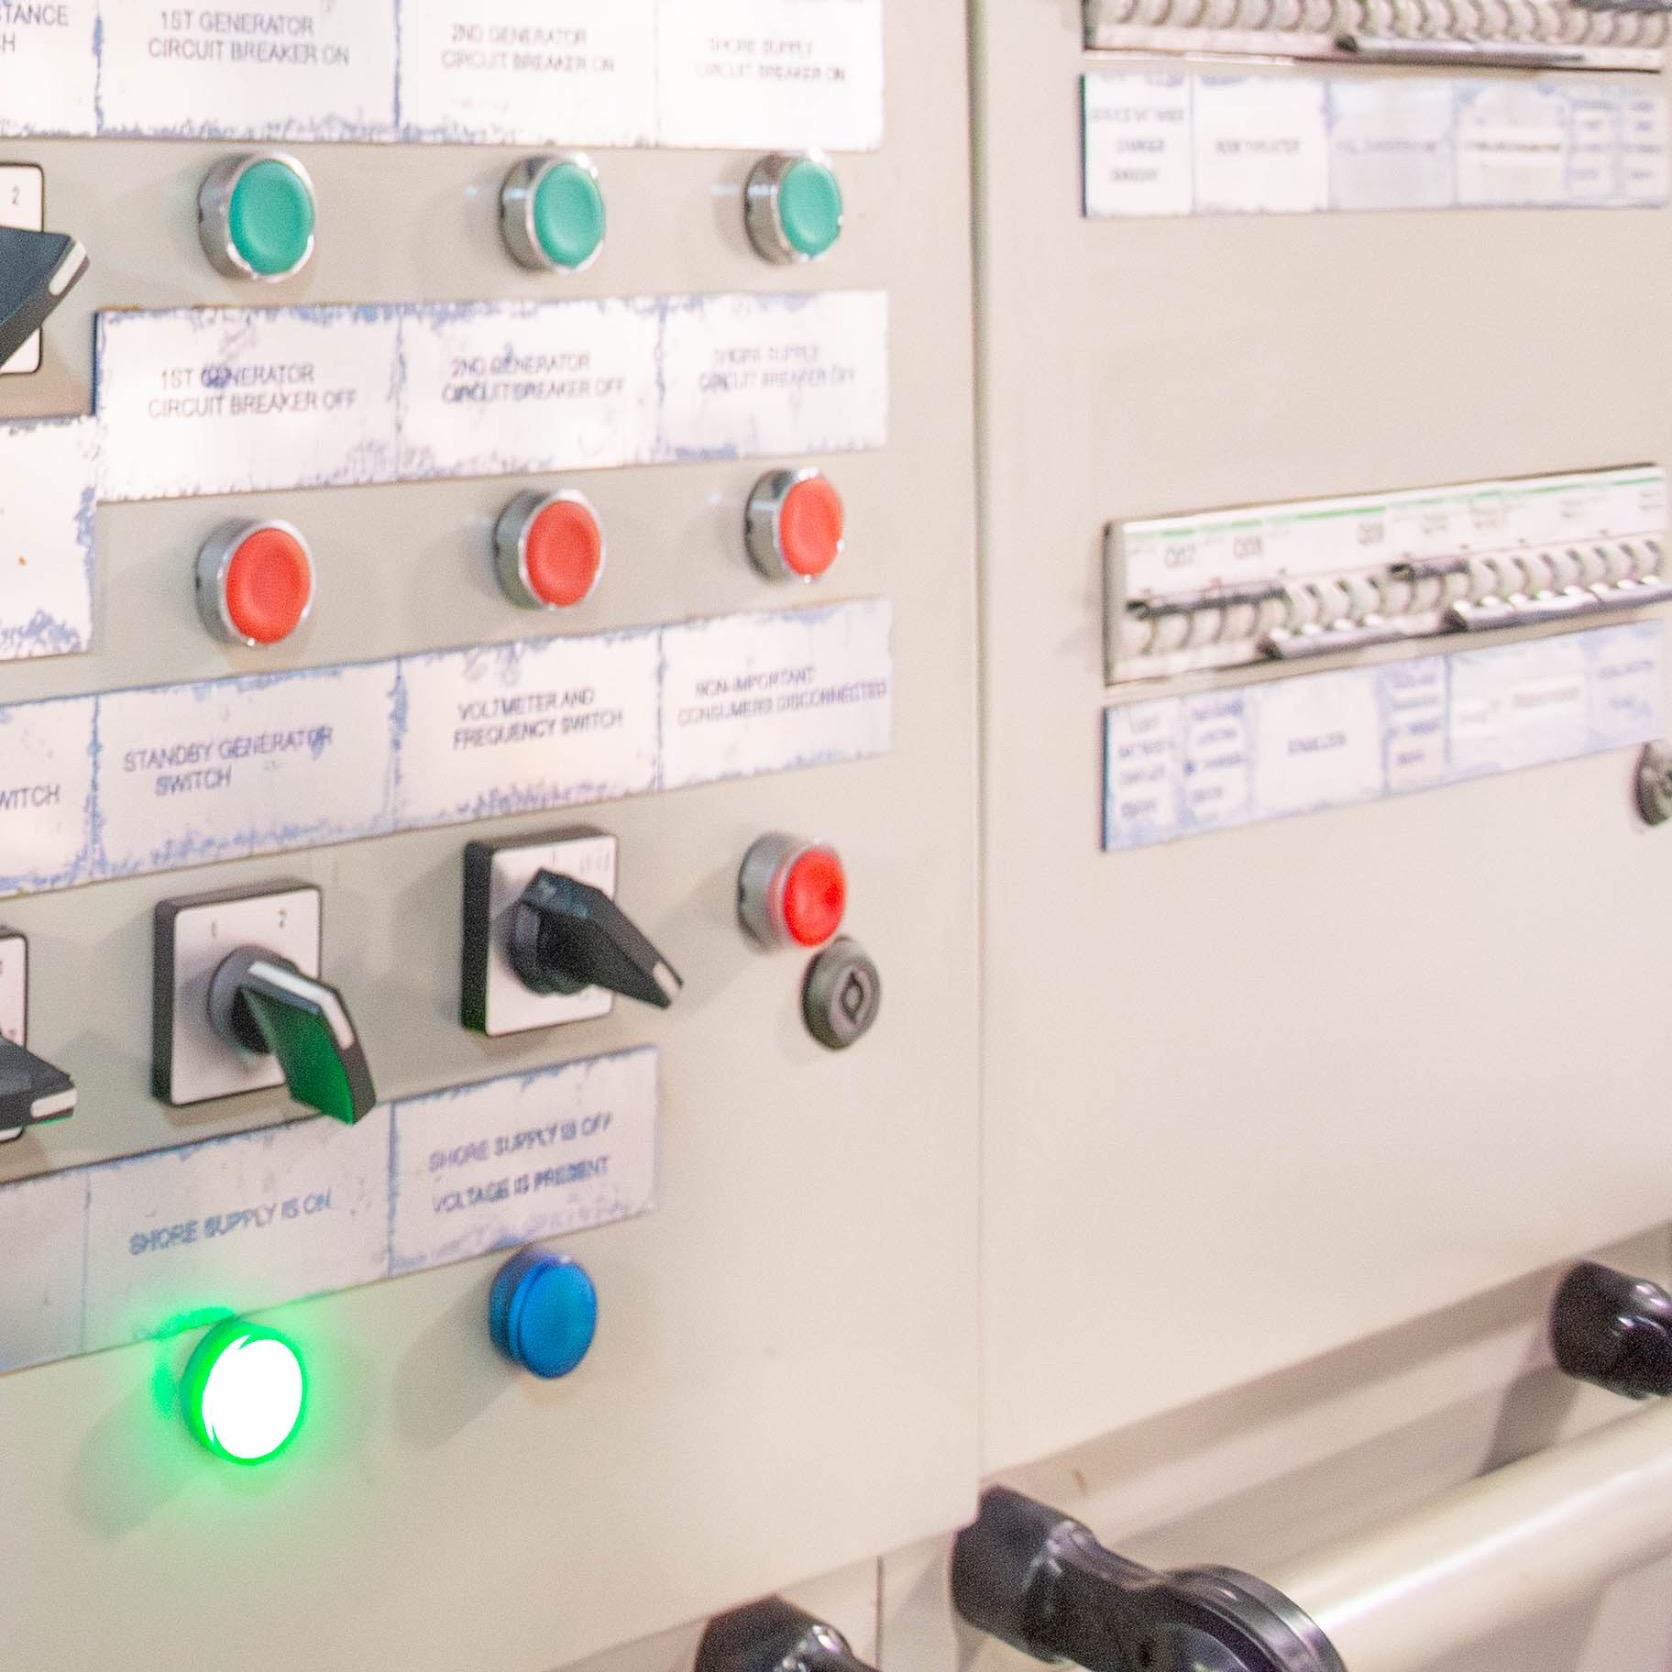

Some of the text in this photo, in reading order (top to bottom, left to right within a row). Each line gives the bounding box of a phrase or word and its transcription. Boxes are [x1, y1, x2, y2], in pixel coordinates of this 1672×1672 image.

[160, 9, 314, 36] 1ST GENERATOR
[489, 22, 588, 48] GENERATOR
[148, 37, 350, 67] CIRCUIT BREAKER ON
[440, 49, 588, 73] CIRCUIT BREAKER
[12, 186, 20, 206] 2
[161, 367, 193, 389] 1ST
[595, 377, 625, 396] OFF
[148, 388, 357, 419] CIRCUIT BREAKER OFF
[457, 687, 596, 721] VOLTMETER AND
[452, 709, 623, 750] FREQUENCY SWITCH
[123, 728, 333, 773] STANDBY GENERATOR
[156, 766, 232, 797] SWITCH
[428, 1144, 491, 1173] SHORE
[494, 1125, 557, 1157] SUPPLY
[432, 1177, 511, 1214] VOLTAGE
[128, 1188, 332, 1256] SHORE SUPPLY ON
